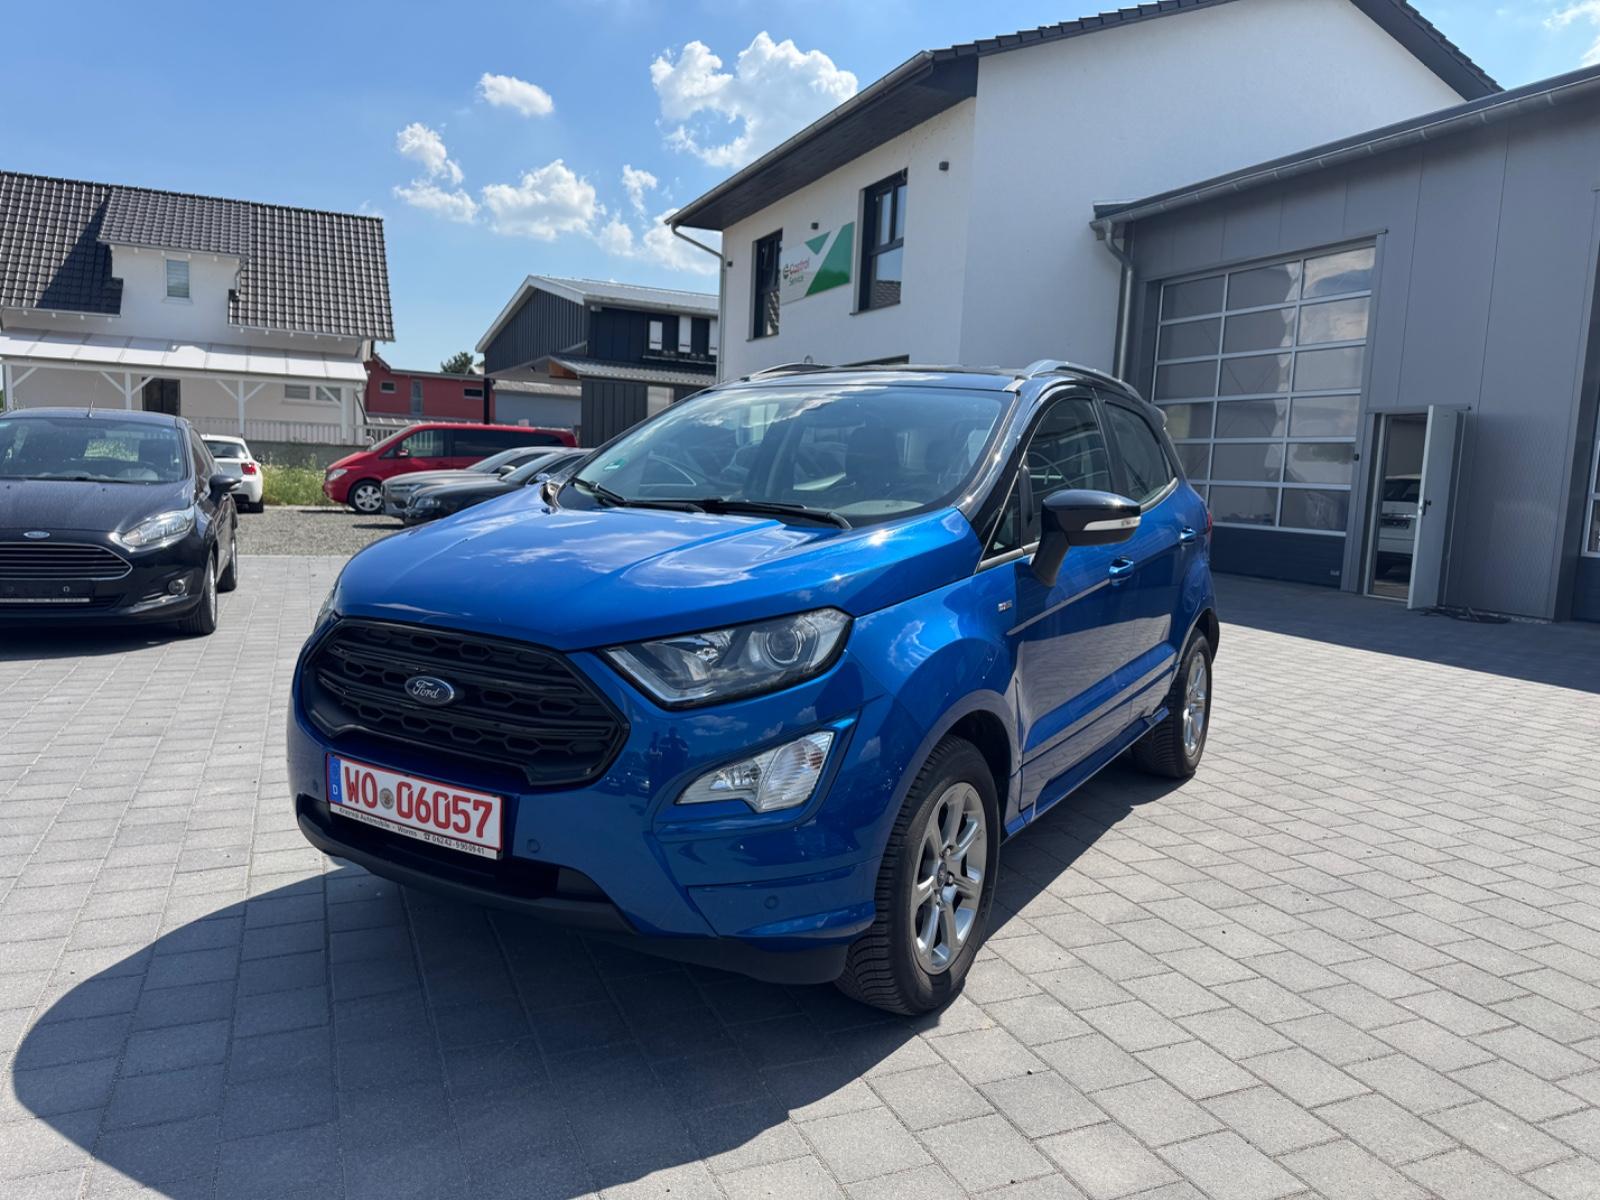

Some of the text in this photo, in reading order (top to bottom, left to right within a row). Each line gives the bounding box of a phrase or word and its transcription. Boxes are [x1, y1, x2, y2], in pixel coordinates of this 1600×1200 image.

[412, 680, 440, 699] Ford
[332, 765, 493, 838] D WO 06057
[397, 825, 418, 837] Worms
